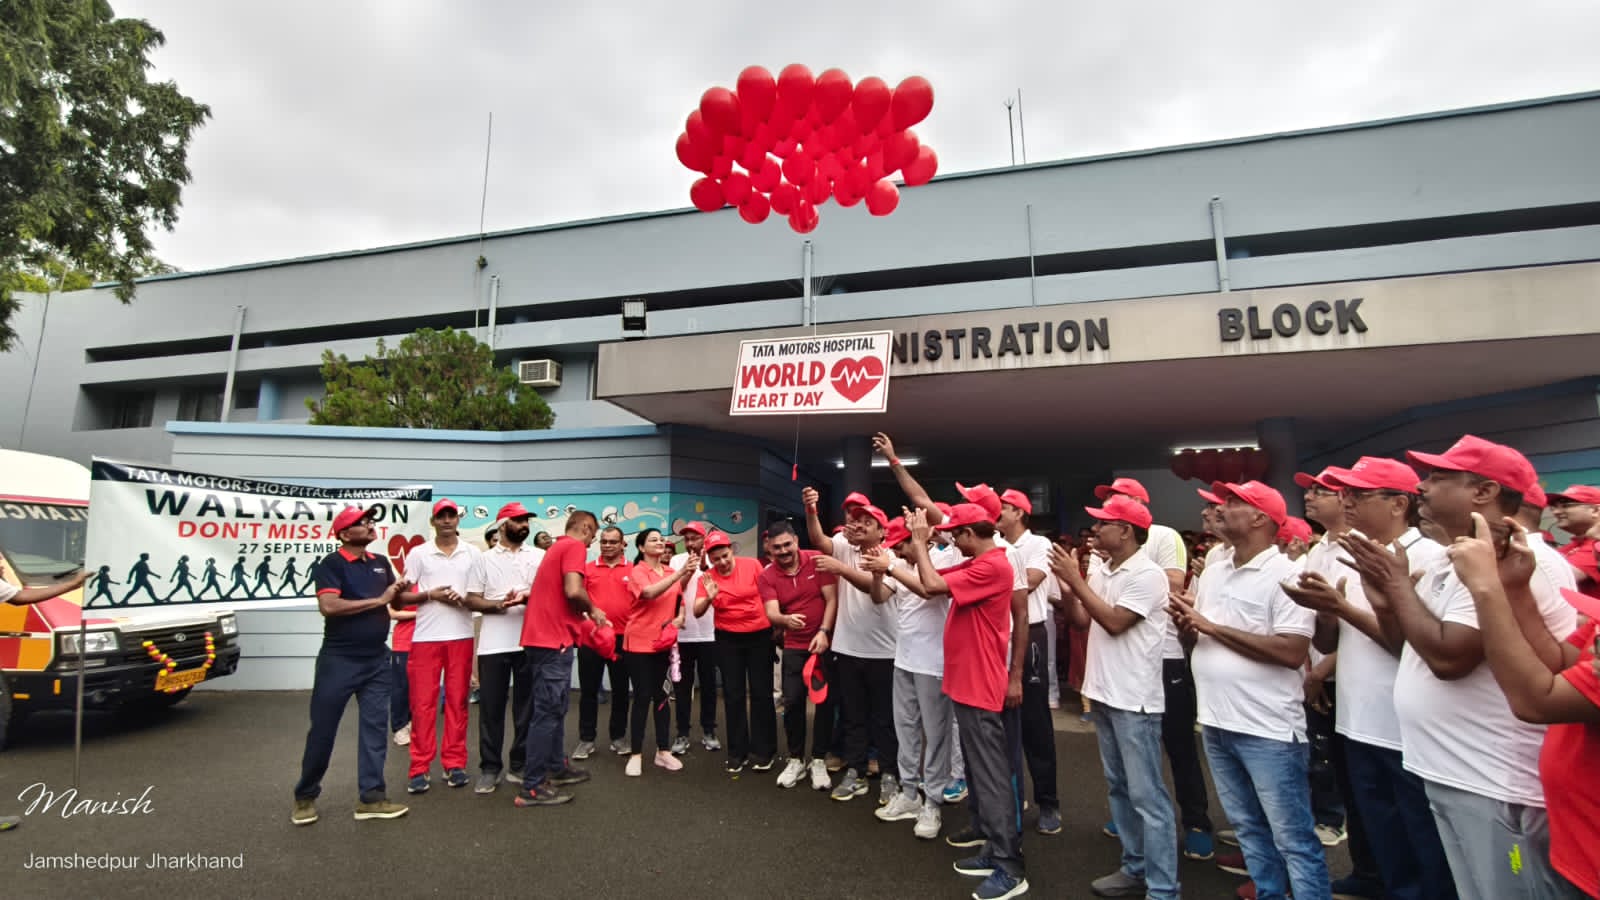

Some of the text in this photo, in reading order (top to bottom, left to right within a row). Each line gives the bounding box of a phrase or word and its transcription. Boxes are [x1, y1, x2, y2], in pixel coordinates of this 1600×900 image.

[890, 298, 1368, 365] NISTRATION BLOCK
[752, 337, 875, 358] TATA MOTORS HOSPITAL
[741, 360, 826, 389] WORLD
[737, 391, 824, 409] HEART DAY
[127, 467, 172, 484] TATA
[178, 474, 252, 492] MOTORS
[145, 489, 408, 524] WALKATON
[178, 520, 262, 539] DON'T
[268, 523, 321, 540] MISS
[238, 543, 341, 554] 27 SEPTEMBE
